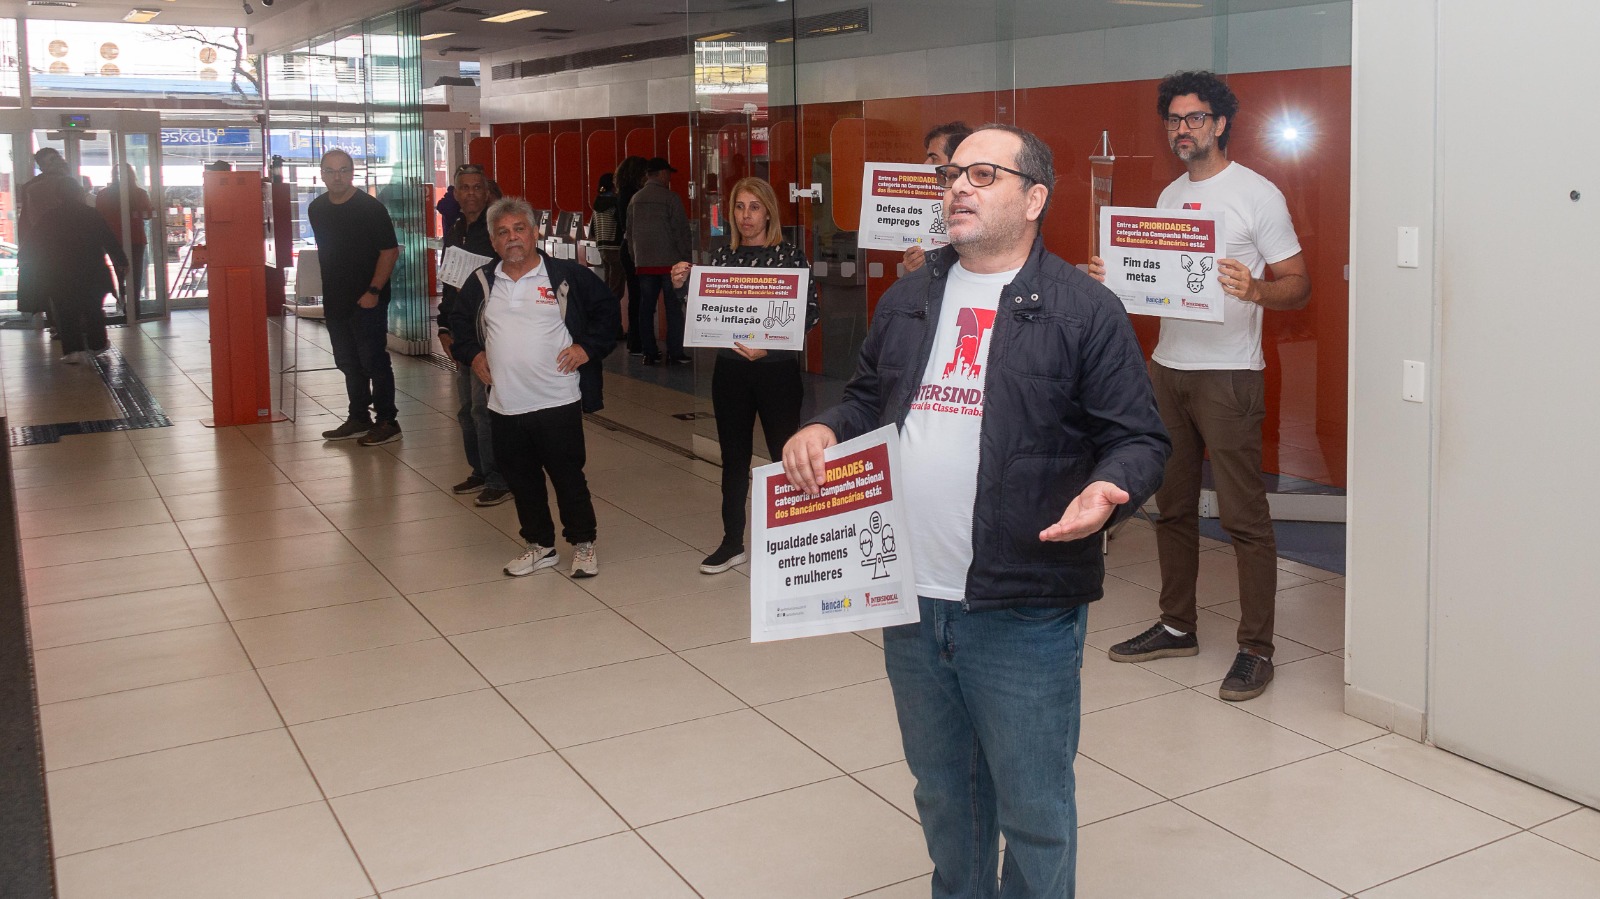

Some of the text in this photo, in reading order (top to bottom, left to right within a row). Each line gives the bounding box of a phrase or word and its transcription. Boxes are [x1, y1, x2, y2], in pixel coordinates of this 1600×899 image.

[876, 204, 922, 214] Defesa dos
[878, 217, 920, 227] empregos
[1139, 221, 1191, 231] PRIORIDADES
[1123, 257, 1160, 269] Fim das
[1126, 272, 1156, 282] metas
[702, 304, 744, 313] Reajuste
[722, 315, 760, 325] inflação
[915, 384, 983, 406] NTERSIND
[933, 403, 959, 414] Classe
[961, 406, 983, 417] Traba
[826, 460, 864, 482] RIDADES
[865, 461, 874, 471] da
[775, 492, 810, 507] categoria
[821, 481, 855, 497] Campanha
[856, 471, 884, 486] Nacional
[775, 509, 788, 519] dos
[790, 500, 825, 517] Bancários
[832, 490, 864, 507] Bancárias
[865, 487, 882, 498] está:
[767, 524, 856, 555] Igualdade salarial
[778, 546, 848, 569] entre homens
[785, 567, 842, 587] e mulheres
